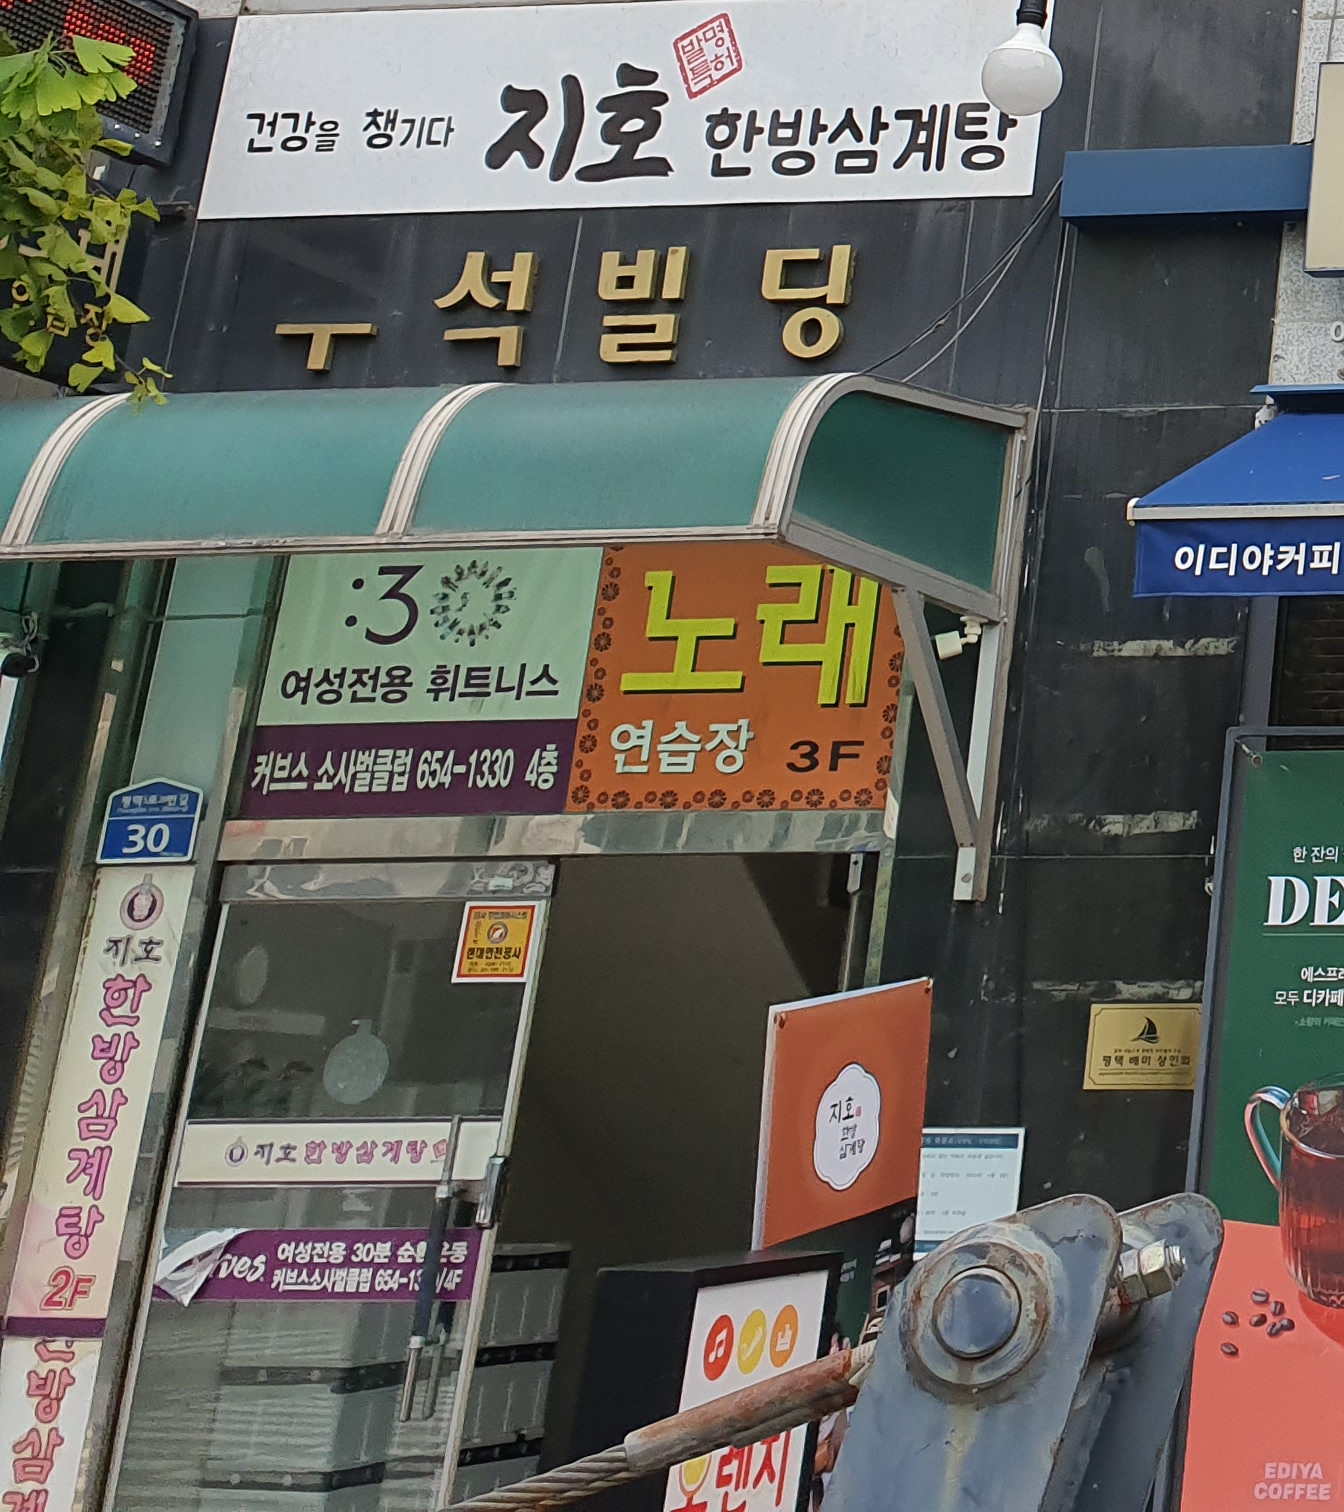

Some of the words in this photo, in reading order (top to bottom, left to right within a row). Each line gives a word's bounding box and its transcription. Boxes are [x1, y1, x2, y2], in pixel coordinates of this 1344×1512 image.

[246, 111, 340, 153] 건강을
[362, 108, 455, 150] 챙기다
[484, 63, 675, 182] 지호
[705, 102, 1018, 178] 한방삼계탕
[1174, 542, 1341, 576] 이디야커피
[620, 564, 880, 707] 노래
[280, 665, 413, 706] 여성전용
[426, 663, 559, 701] 휘트니스
[610, 719, 755, 774] 연습장
[786, 740, 865, 772] 3F
[251, 751, 307, 795] 커브스
[313, 748, 414, 793] 소사벌클럽
[417, 748, 514, 789] 654-1330
[525, 744, 559, 790] 4층
[122, 823, 170, 853] 30
[1293, 846, 1307, 863] 한
[1311, 846, 1339, 863] 잔의
[103, 934, 164, 967] 지호
[1274, 991, 1299, 1006] 모두
[55, 973, 152, 1260] 한방삼계탕
[829, 1096, 854, 1123] 지호
[254, 1142, 297, 1166] 지호
[277, 1241, 346, 1264] 여성전용
[351, 1241, 392, 1263] 30분
[40, 1265, 96, 1310] 2F
[1264, 1462, 1324, 1480] EDIYA
[1254, 1482, 1332, 1501] COFFEE
